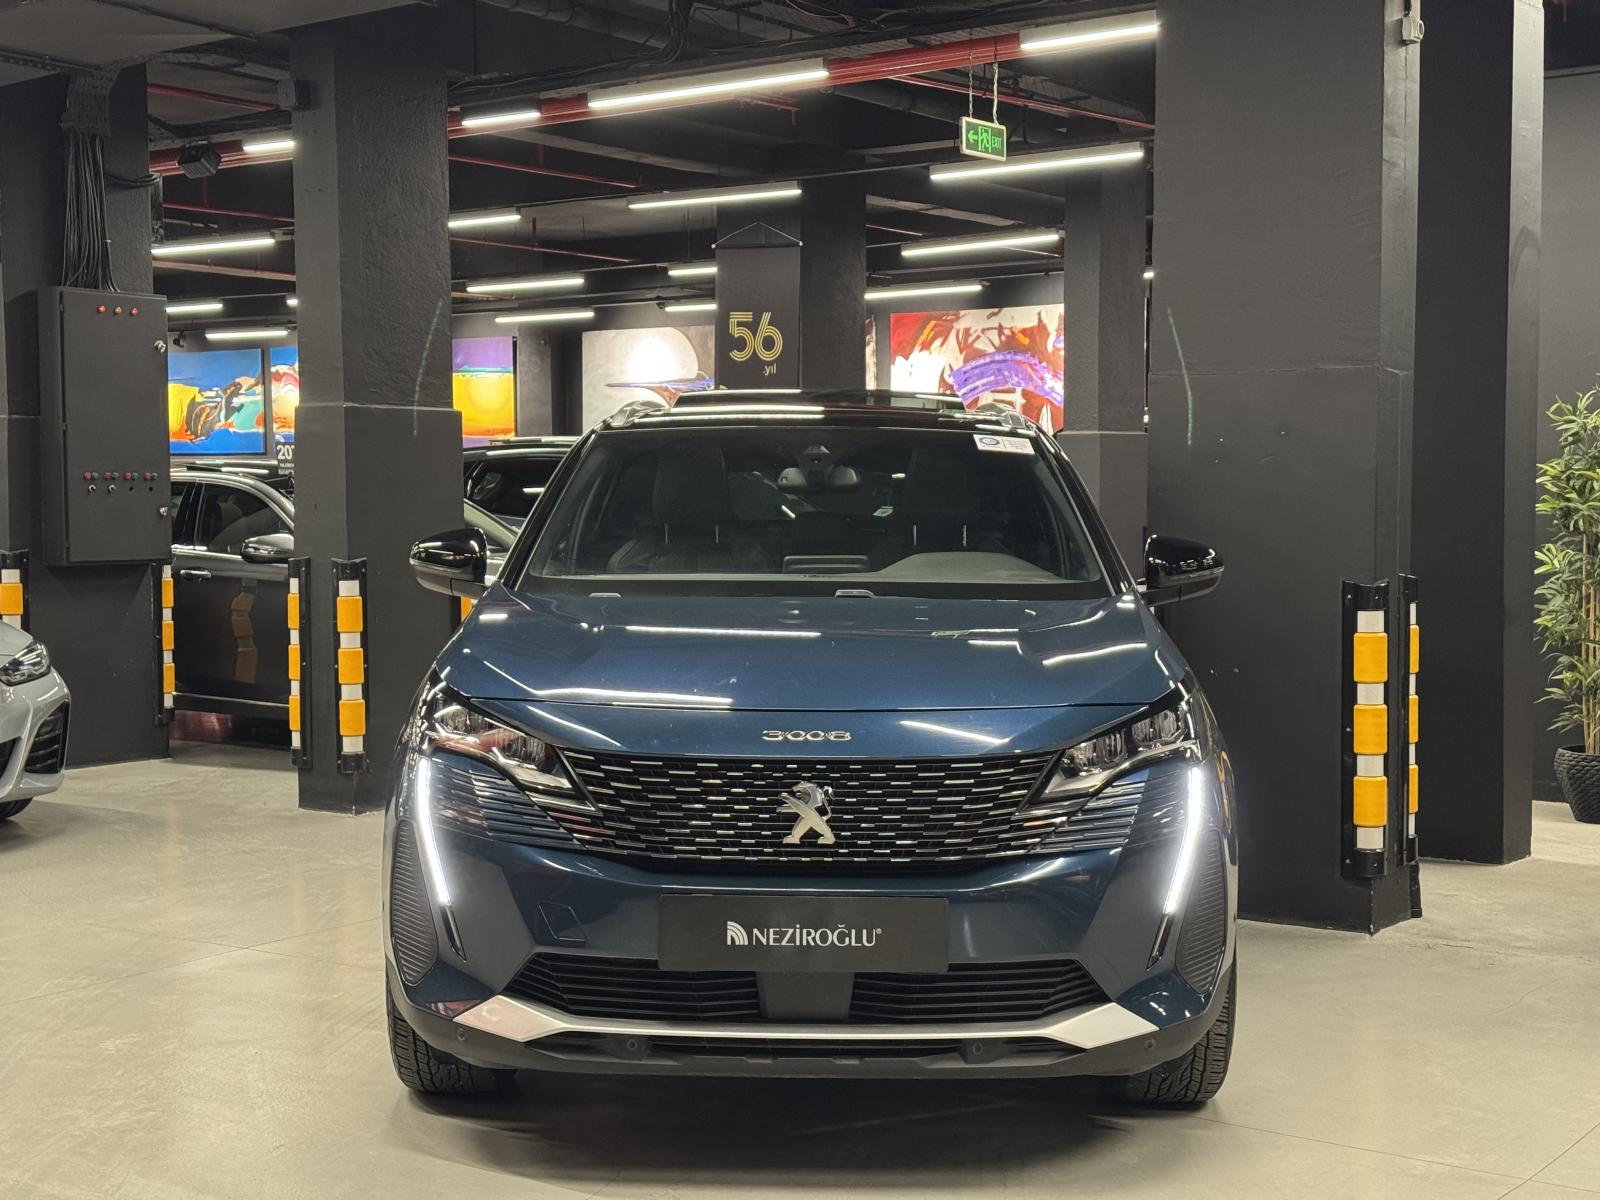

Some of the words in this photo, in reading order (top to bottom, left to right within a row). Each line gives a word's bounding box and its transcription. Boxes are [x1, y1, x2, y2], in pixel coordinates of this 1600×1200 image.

[729, 311, 783, 361] 56
[762, 730, 852, 741] 3008
[752, 923, 877, 947] NEZİROĞLU
